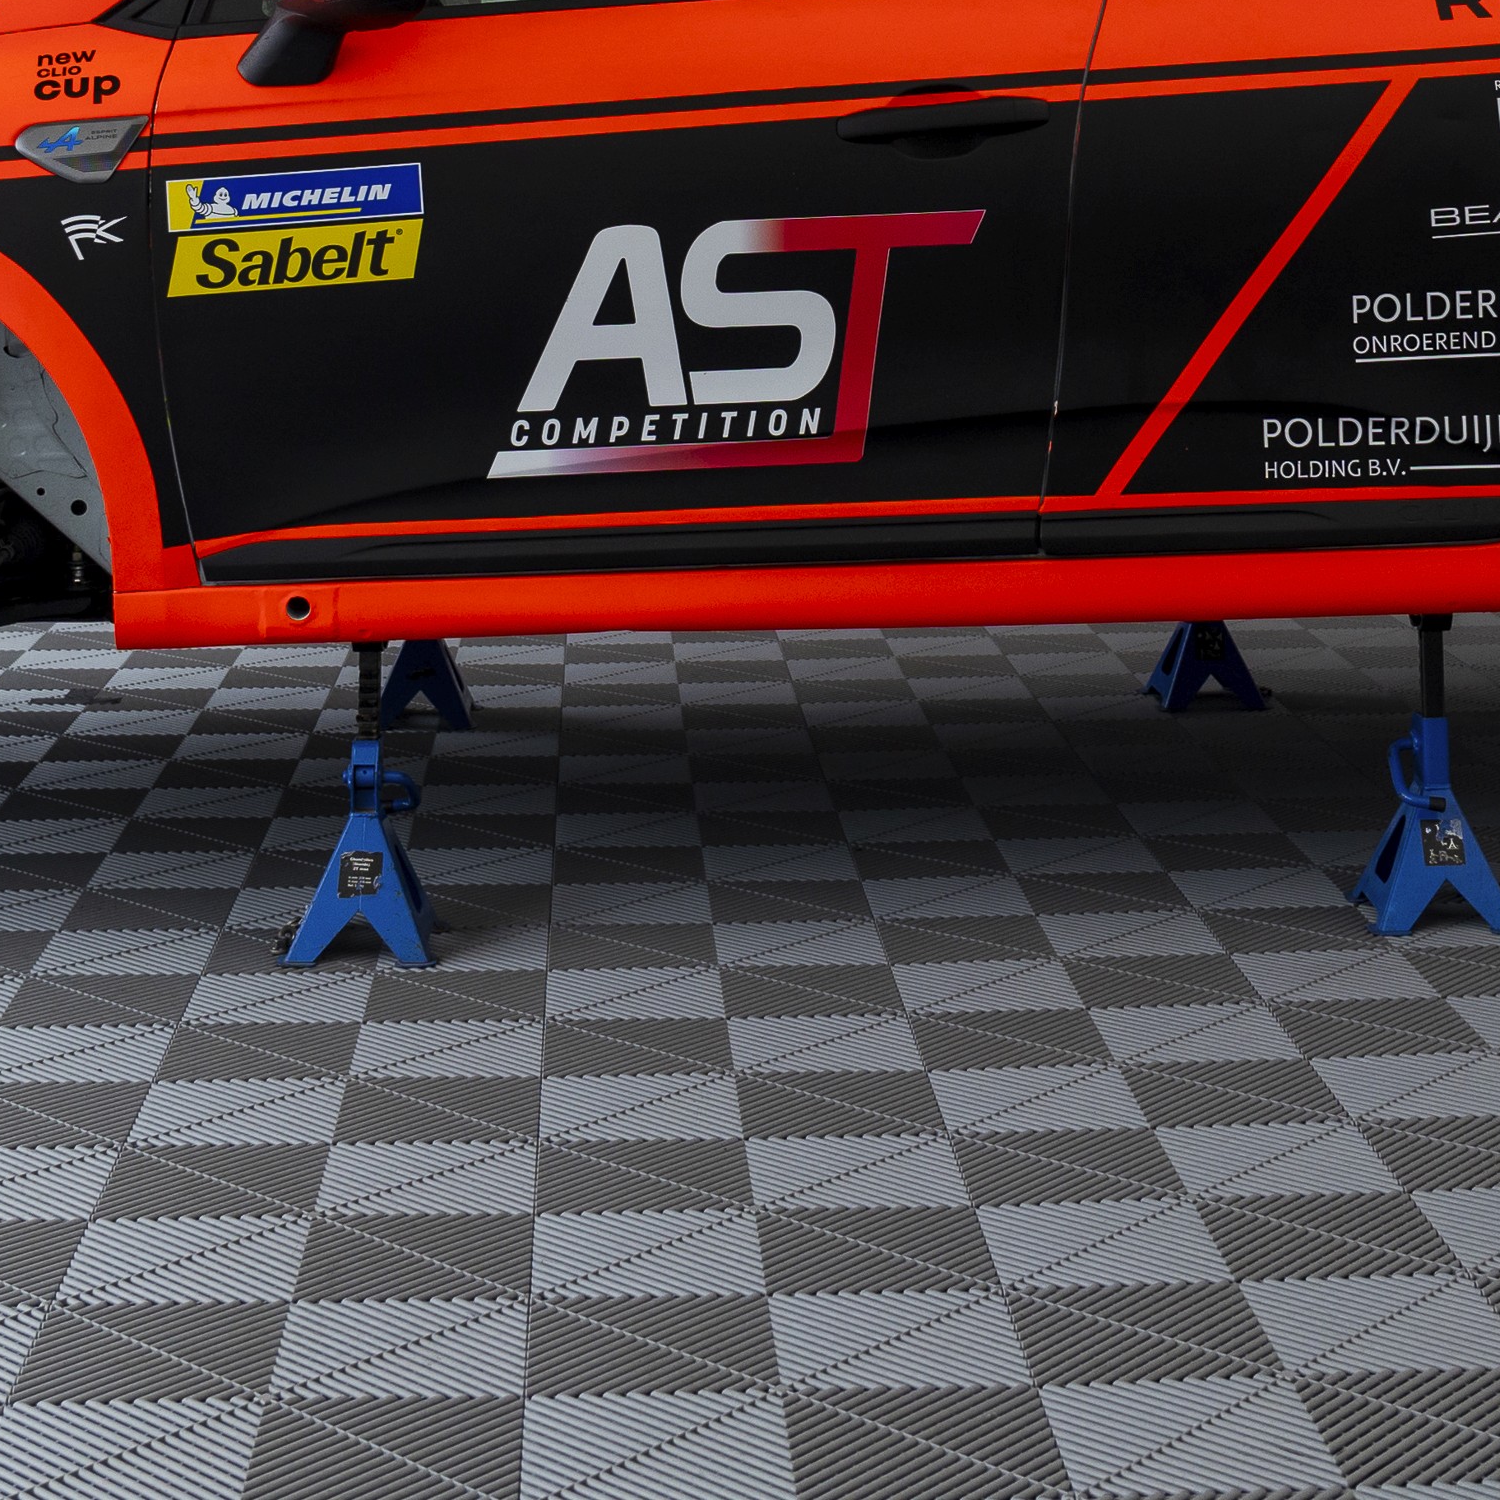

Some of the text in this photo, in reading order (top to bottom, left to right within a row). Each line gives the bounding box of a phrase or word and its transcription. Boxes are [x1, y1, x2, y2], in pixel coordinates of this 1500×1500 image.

[37, 66, 82, 78] CLIO
[38, 49, 96, 67] new
[34, 75, 121, 104] cup
[241, 183, 392, 211] MICHELIN
[195, 230, 395, 289] Sabelt
[517, 209, 986, 462] AST
[1353, 330, 1497, 355] ONROEREND
[510, 408, 821, 447] COMPETITION
[1264, 458, 1406, 479] HOLDING B.V.
